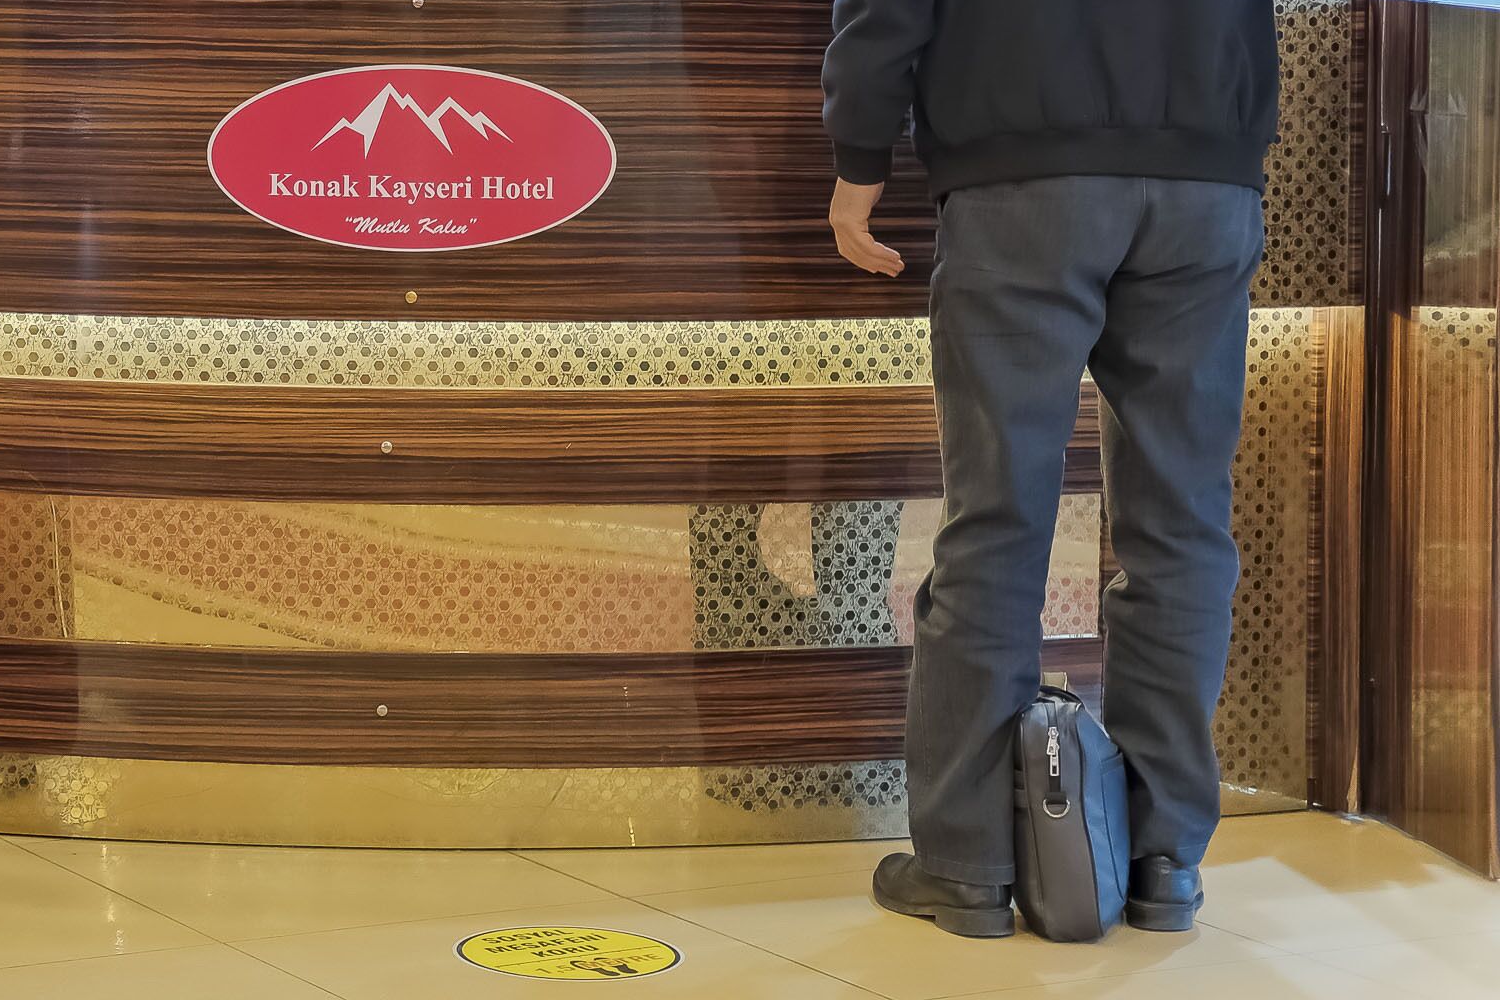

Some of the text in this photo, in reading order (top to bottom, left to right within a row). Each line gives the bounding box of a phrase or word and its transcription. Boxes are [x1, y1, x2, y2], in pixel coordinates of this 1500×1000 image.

[268, 173, 555, 205] Konak Kayseri Hotel
[482, 929, 574, 944] SOSYAL
[484, 933, 609, 954] MESAFENİ
[531, 944, 600, 958] KORU
